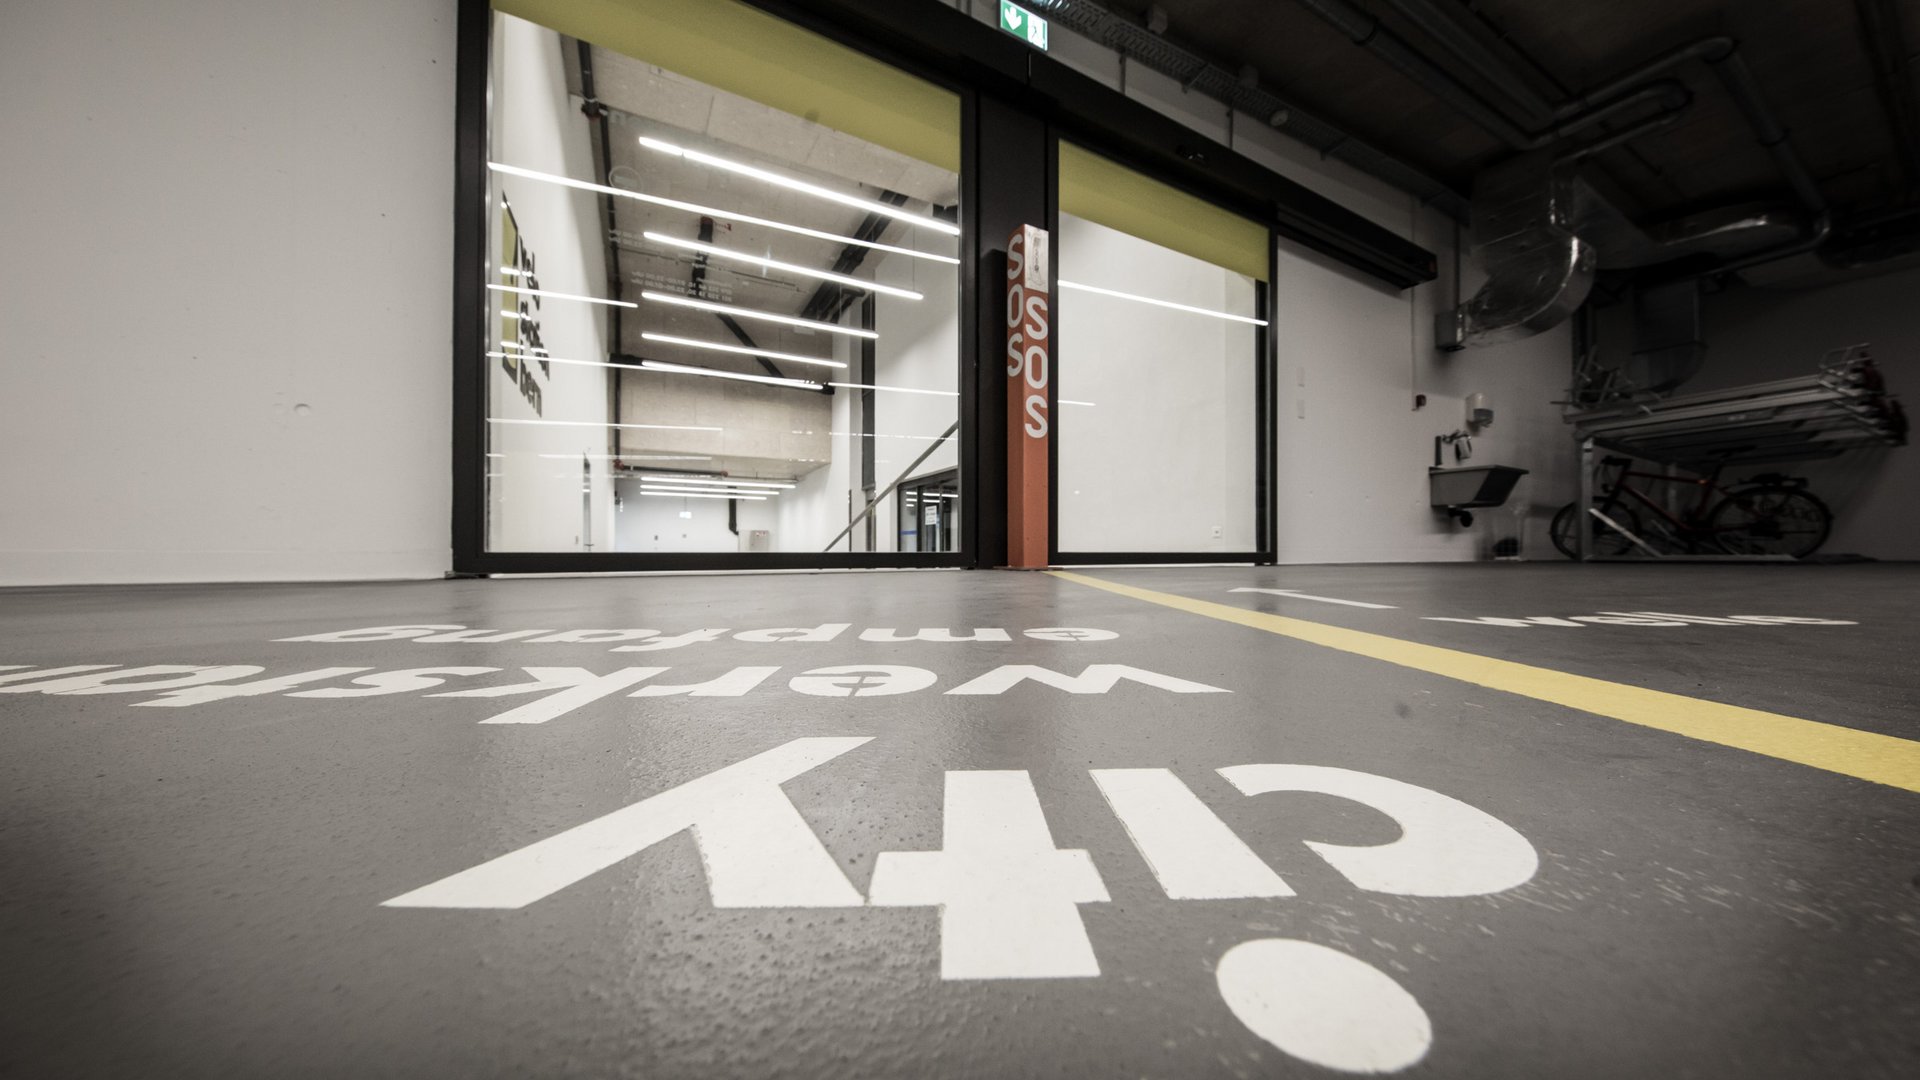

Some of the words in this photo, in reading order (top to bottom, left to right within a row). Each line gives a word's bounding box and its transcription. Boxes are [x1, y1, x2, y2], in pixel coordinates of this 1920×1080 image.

[1007, 232, 1024, 378] SOS
[1025, 295, 1049, 439] SOS
[269, 623, 1121, 652] empfang
[1418, 611, 1860, 628] welle
[0, 664, 1234, 725] werksta
[378, 736, 1540, 1073] city
